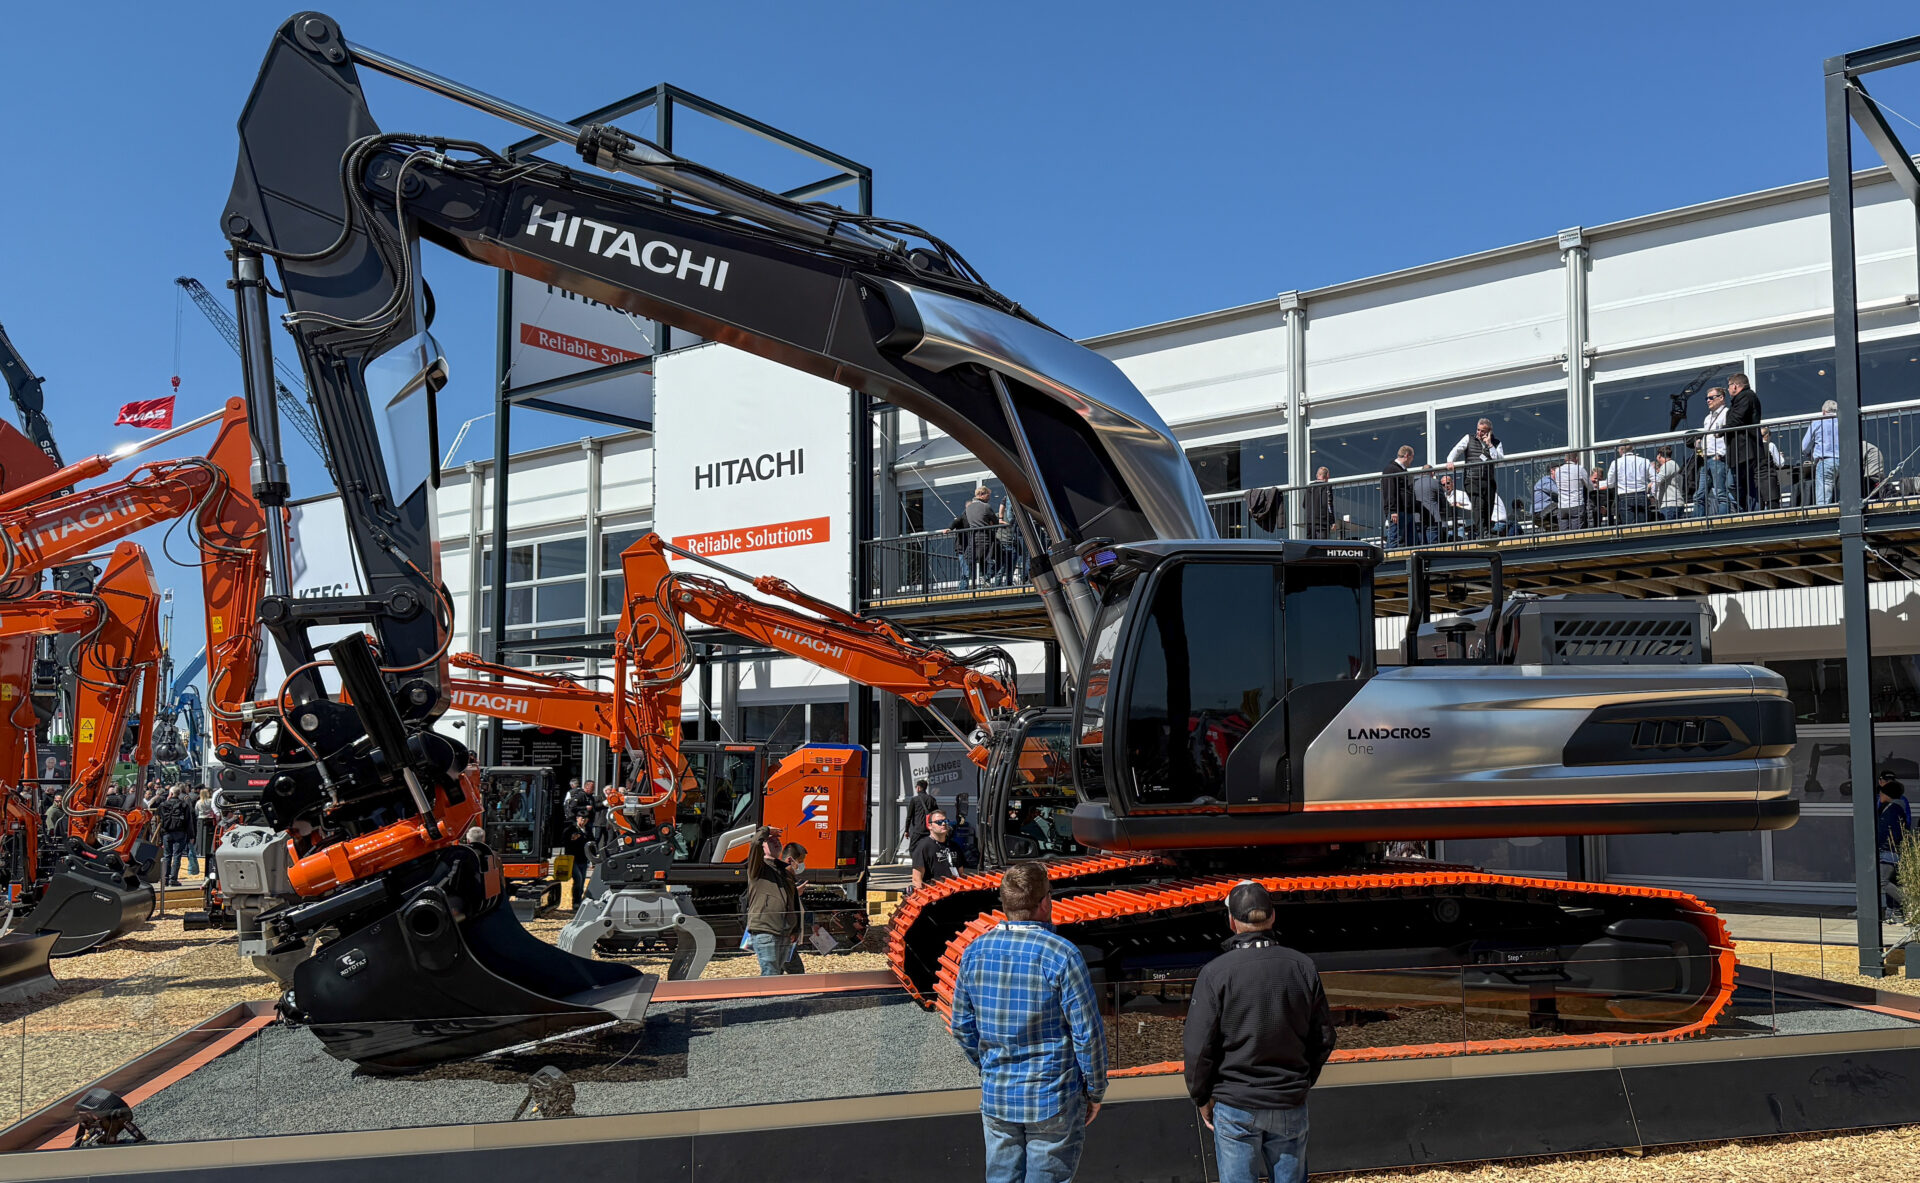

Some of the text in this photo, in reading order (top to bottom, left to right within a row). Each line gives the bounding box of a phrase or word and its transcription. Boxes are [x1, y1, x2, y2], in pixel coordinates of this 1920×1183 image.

[526, 204, 730, 292] HITACHI
[538, 331, 597, 359] Reliable
[695, 448, 804, 491] HITACHI
[9, 495, 137, 556] HITACHI
[687, 526, 813, 555] Reliable Solutions
[1327, 549, 1364, 558] HITACHI
[773, 624, 844, 659] HITACHI
[1347, 727, 1431, 740] LANDCROS
[1347, 743, 1374, 755] One
[913, 759, 961, 777] CHALLENGES
[804, 786, 829, 794] ZAXIS
[1507, 954, 1520, 963] Step
[1152, 973, 1166, 982] Step
